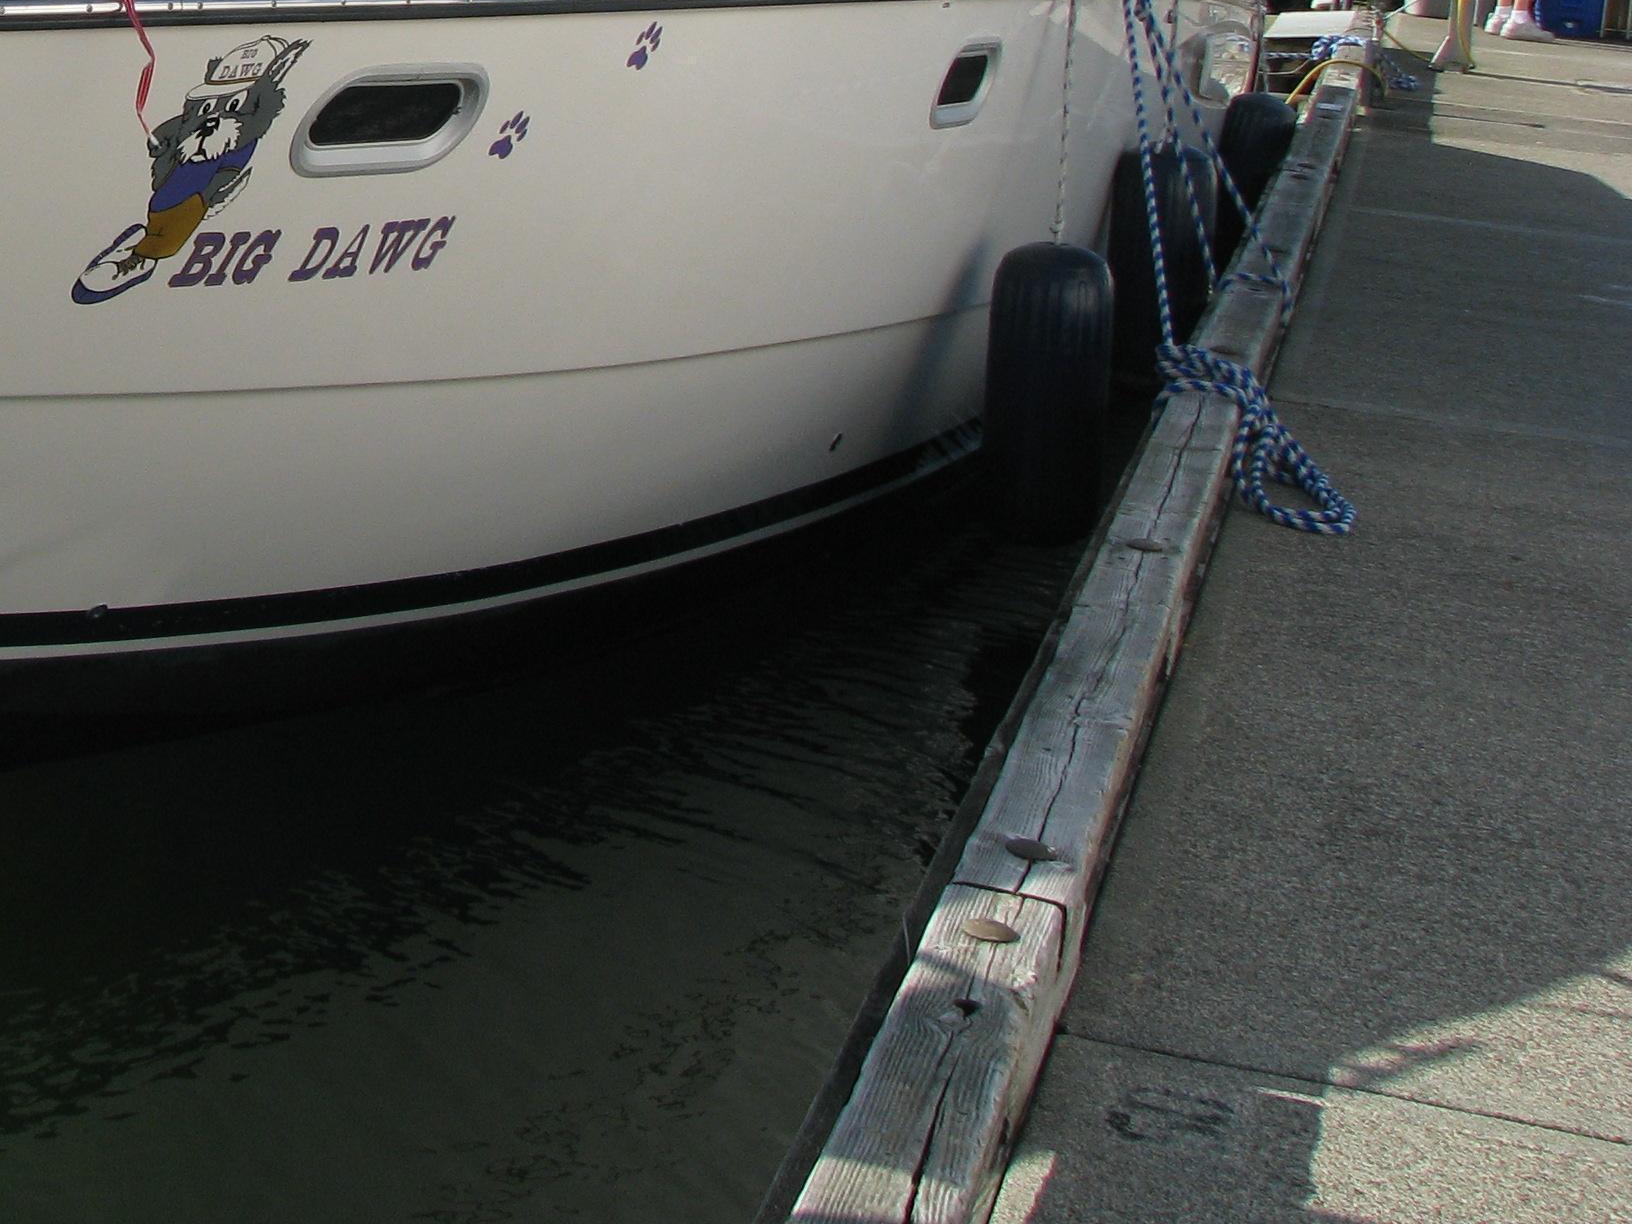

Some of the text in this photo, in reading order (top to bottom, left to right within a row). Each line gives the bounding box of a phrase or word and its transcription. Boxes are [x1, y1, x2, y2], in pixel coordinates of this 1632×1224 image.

[240, 49, 258, 59] BIG
[218, 63, 263, 79] DAWG
[169, 216, 456, 287] BIG DAWG
